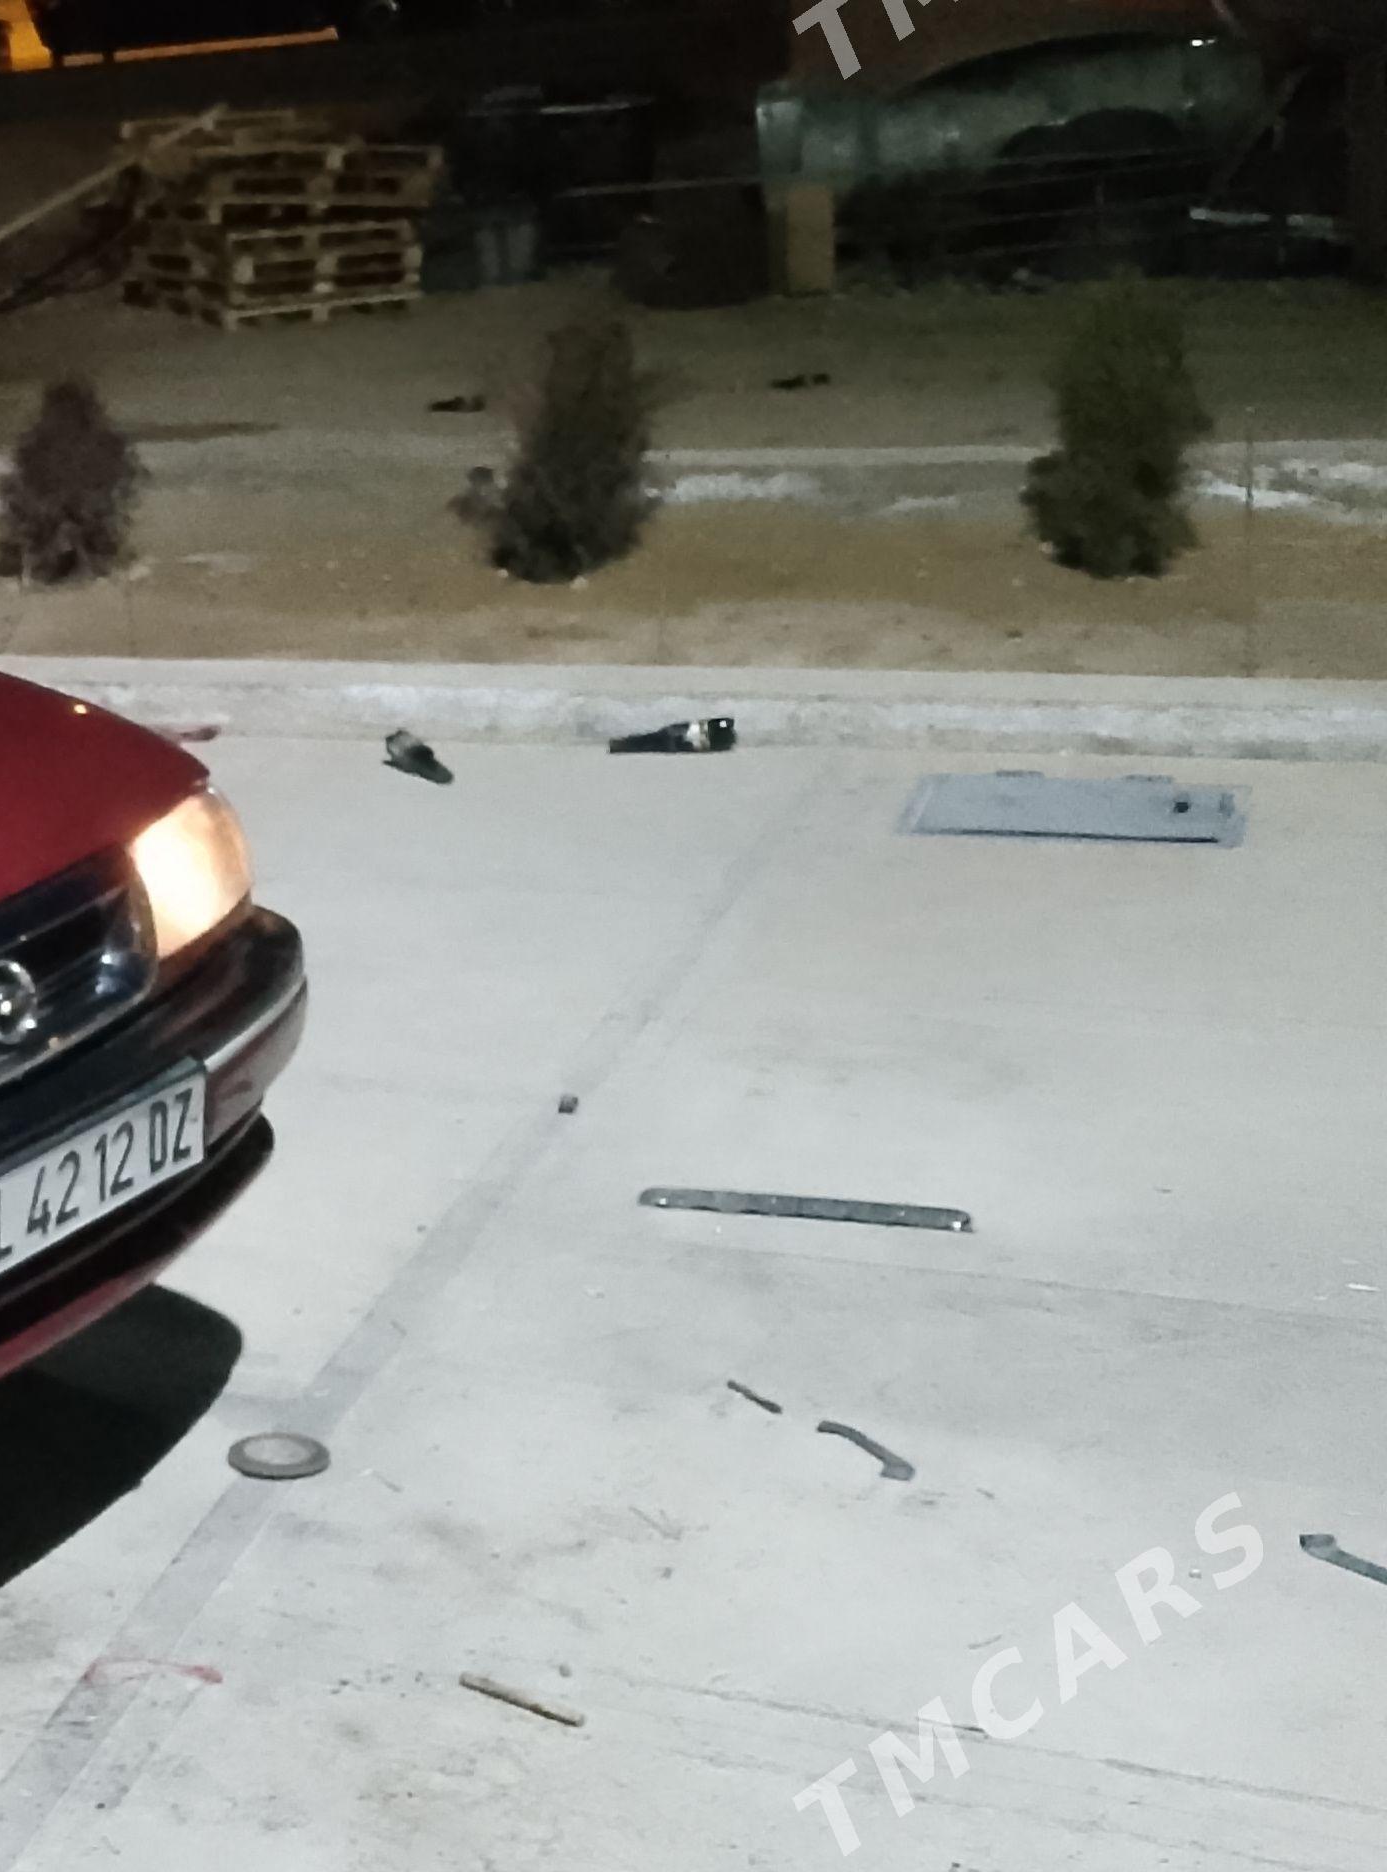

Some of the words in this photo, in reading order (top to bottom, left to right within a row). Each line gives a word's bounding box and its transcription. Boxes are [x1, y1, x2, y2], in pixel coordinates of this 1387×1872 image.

[26, 1150, 81, 1237] 42
[94, 1121, 135, 1203] 12
[149, 1088, 193, 1176] DZ
